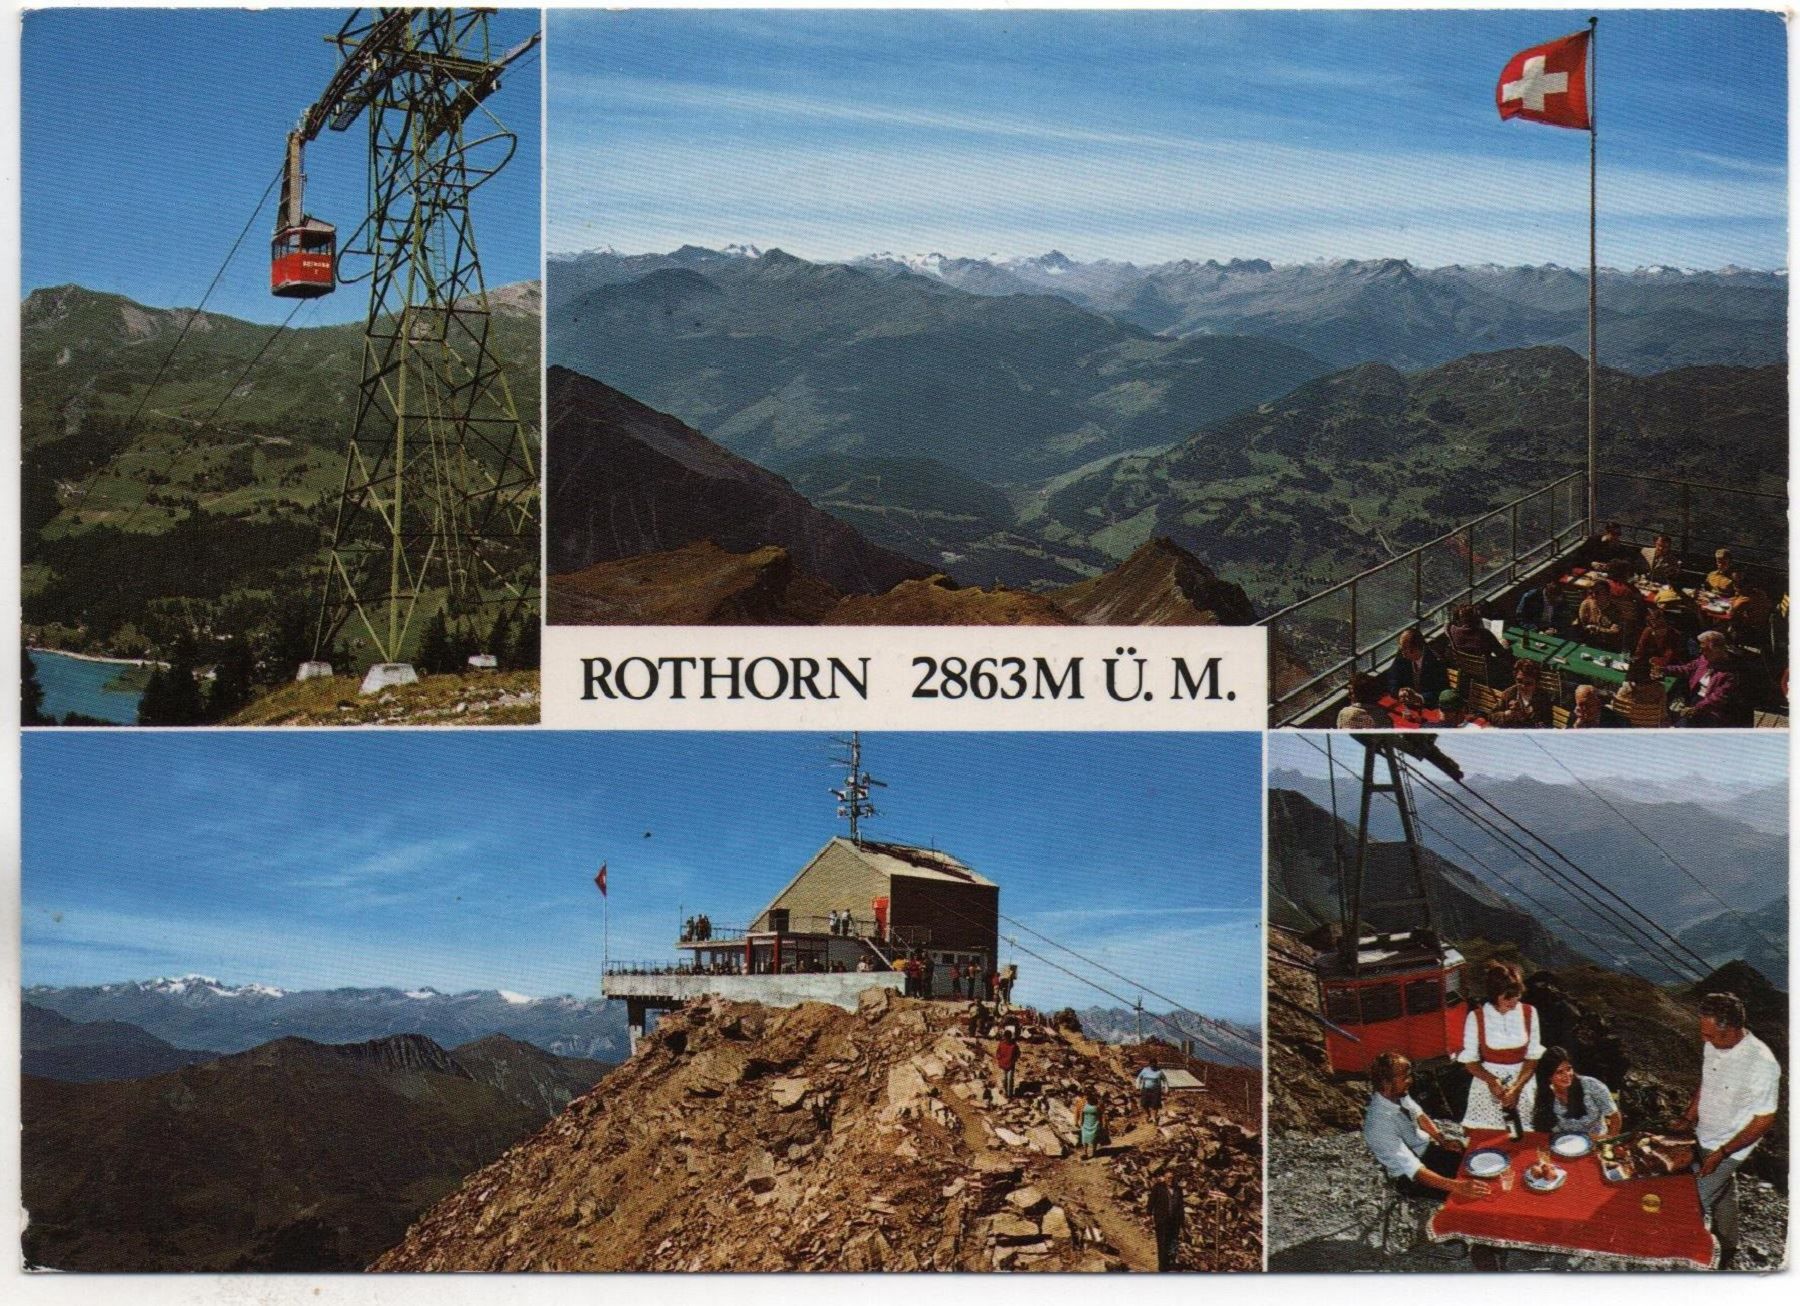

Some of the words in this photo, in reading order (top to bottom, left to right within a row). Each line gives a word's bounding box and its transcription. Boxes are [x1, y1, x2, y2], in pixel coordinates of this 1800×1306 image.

[580, 656, 872, 701] ROTHORN
[911, 656, 1085, 700] 2863M
[1102, 646, 1153, 702] Ü.
[1170, 657, 1236, 702] M.
